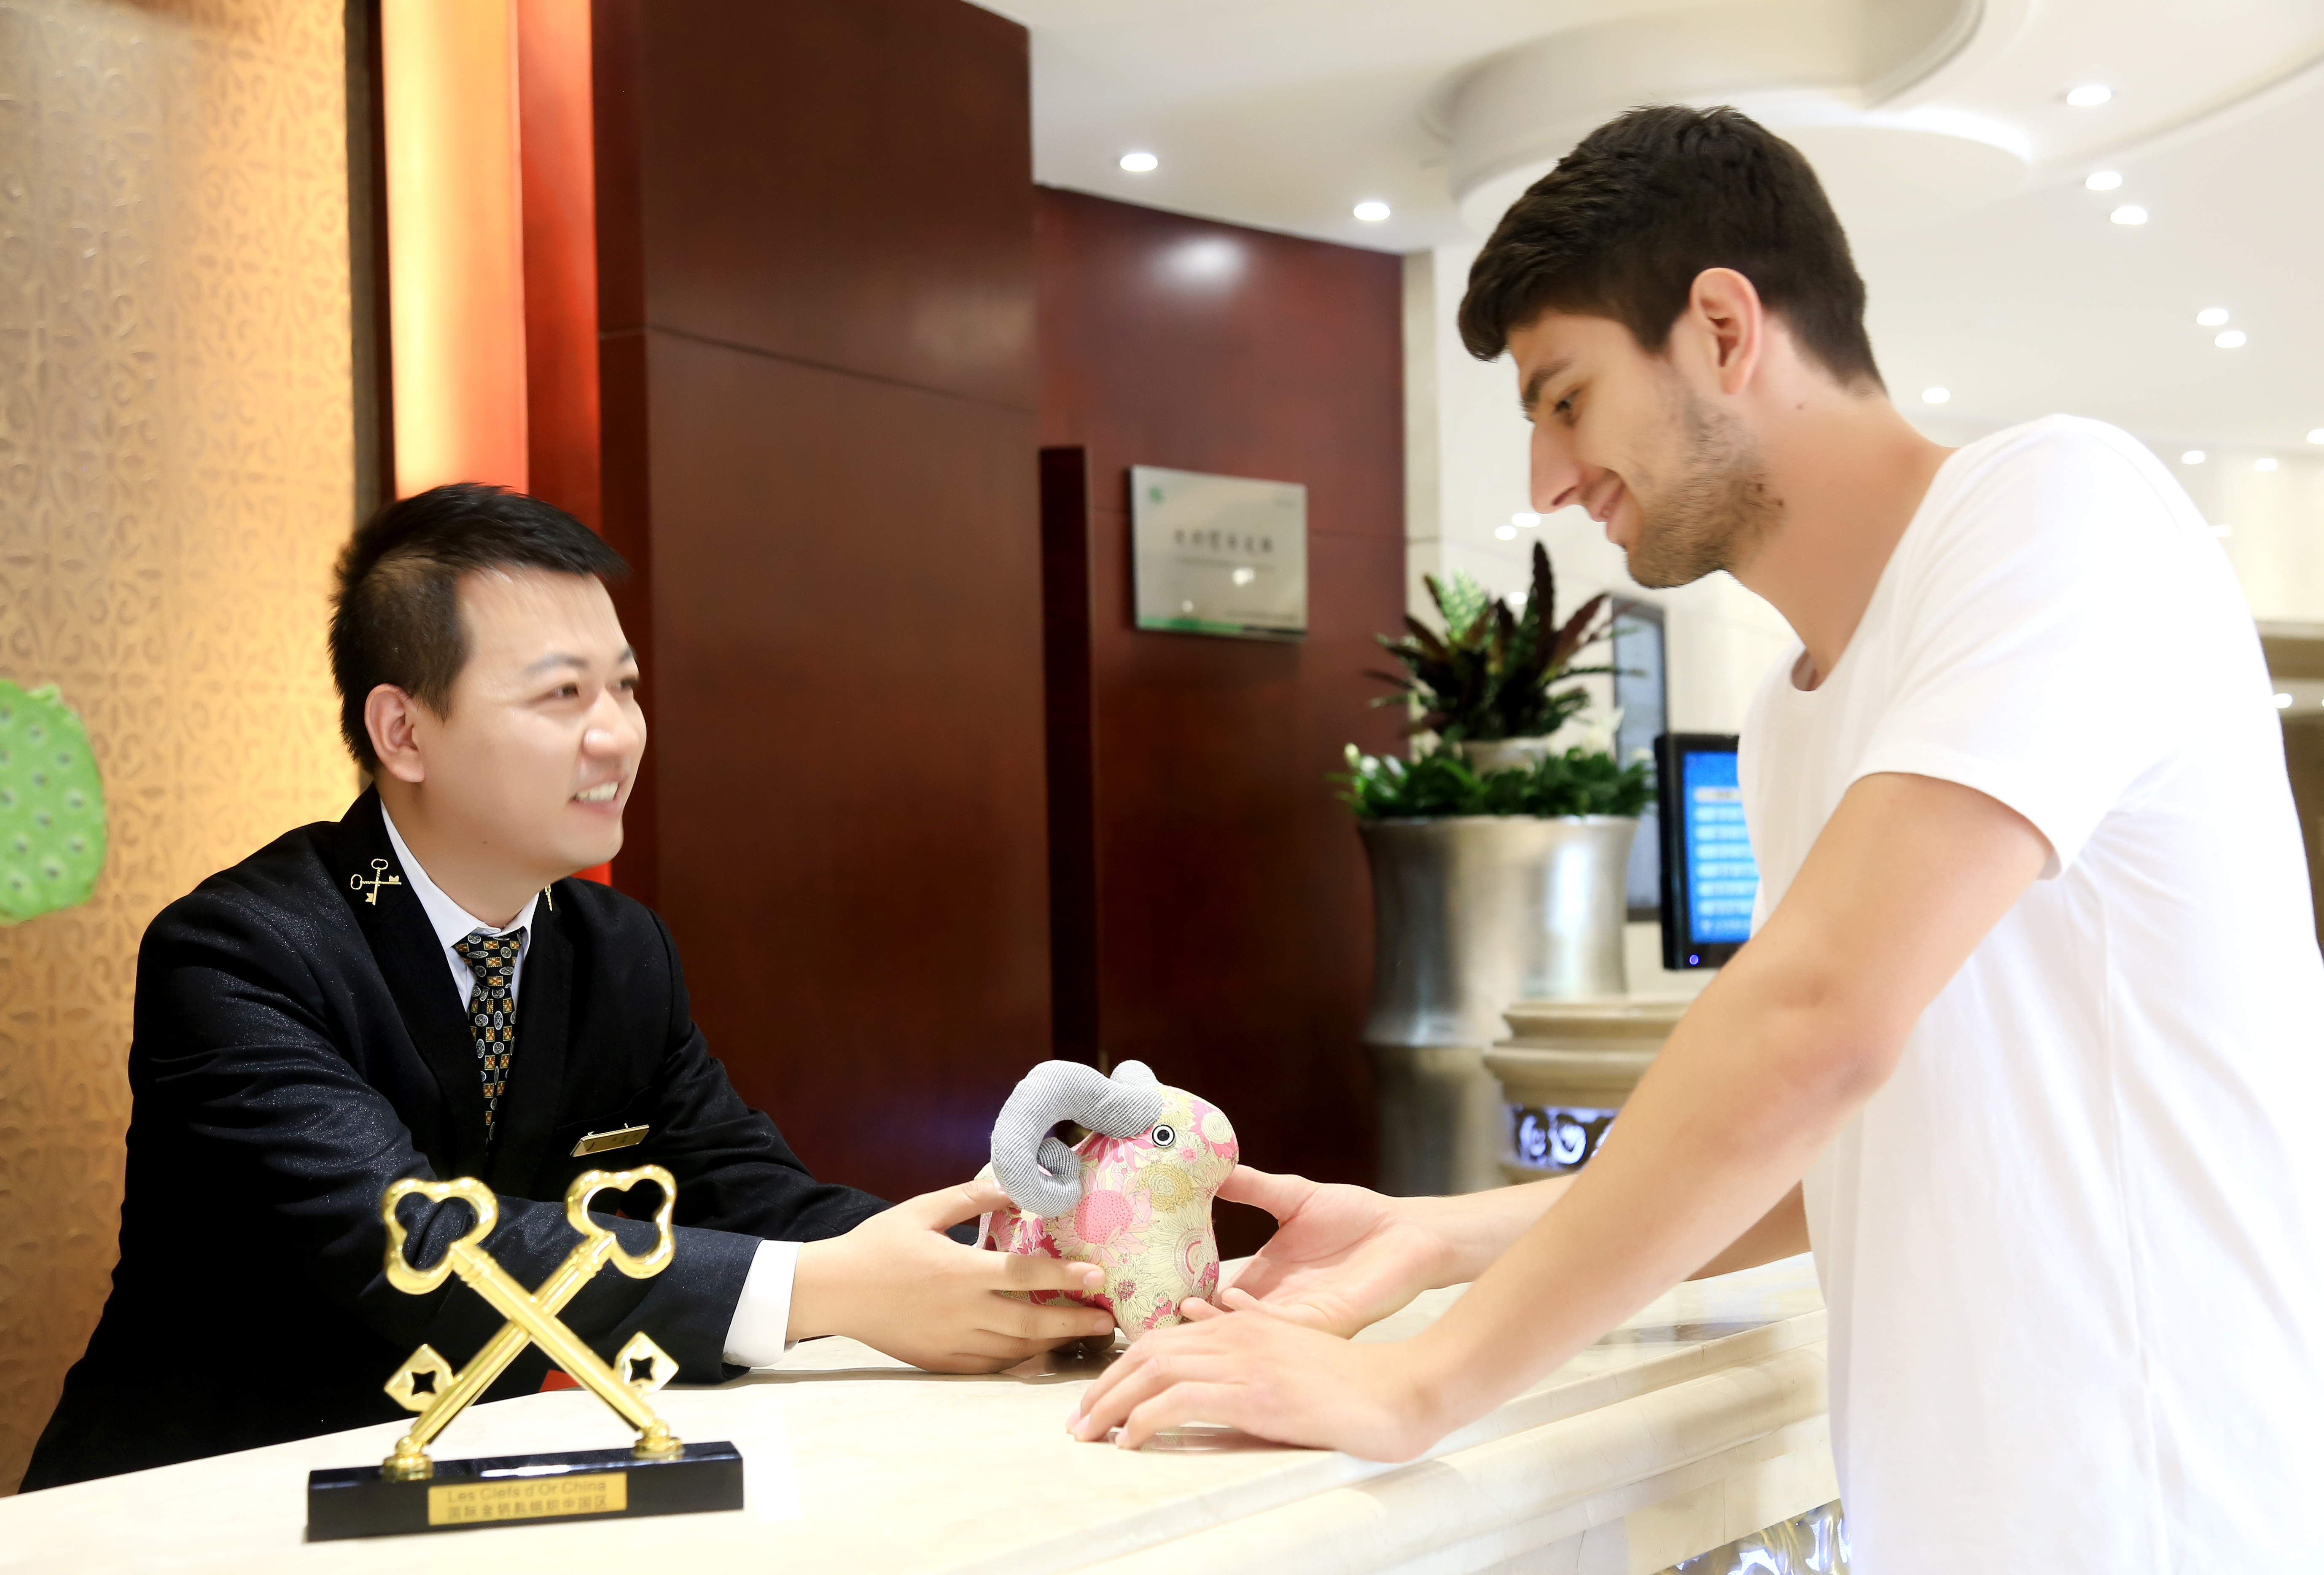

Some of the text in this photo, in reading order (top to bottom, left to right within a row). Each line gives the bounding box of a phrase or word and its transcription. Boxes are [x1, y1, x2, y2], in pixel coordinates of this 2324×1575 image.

[448, 1489, 475, 1502] Les
[481, 1484, 520, 1499] Clefs
[562, 1480, 606, 1494] China
